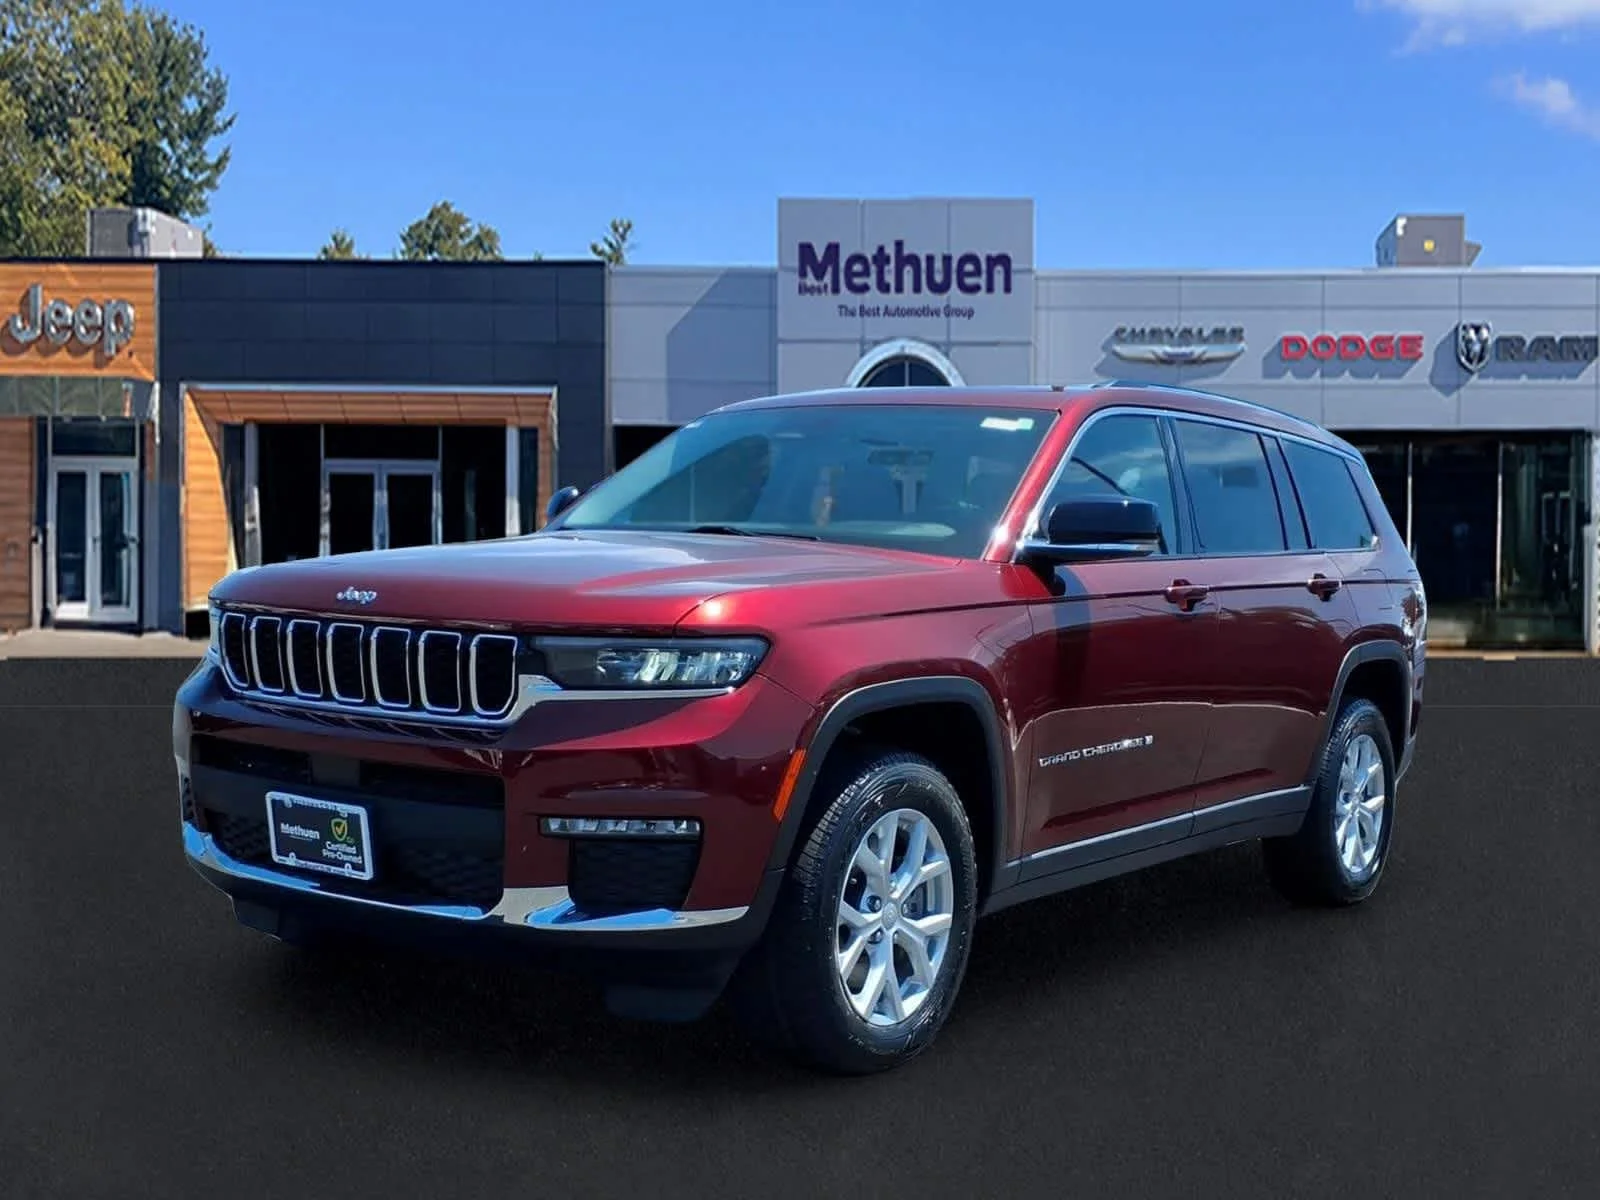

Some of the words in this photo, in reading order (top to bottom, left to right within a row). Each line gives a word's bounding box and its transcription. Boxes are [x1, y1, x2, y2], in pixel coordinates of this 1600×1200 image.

[797, 239, 1013, 295] Methuen
[798, 282, 829, 297] Best
[9, 283, 135, 358] Jeep
[838, 304, 857, 318] The
[859, 304, 881, 318] Best
[883, 304, 941, 318] Automotive
[943, 304, 975, 320] Group
[1113, 327, 1245, 342] CHRYSLER
[1282, 335, 1424, 361] DODGE
[1496, 335, 1598, 361] RAM
[336, 586, 377, 605] Jeep
[1039, 750, 1081, 767] GRAND
[280, 822, 320, 840] Methuen
